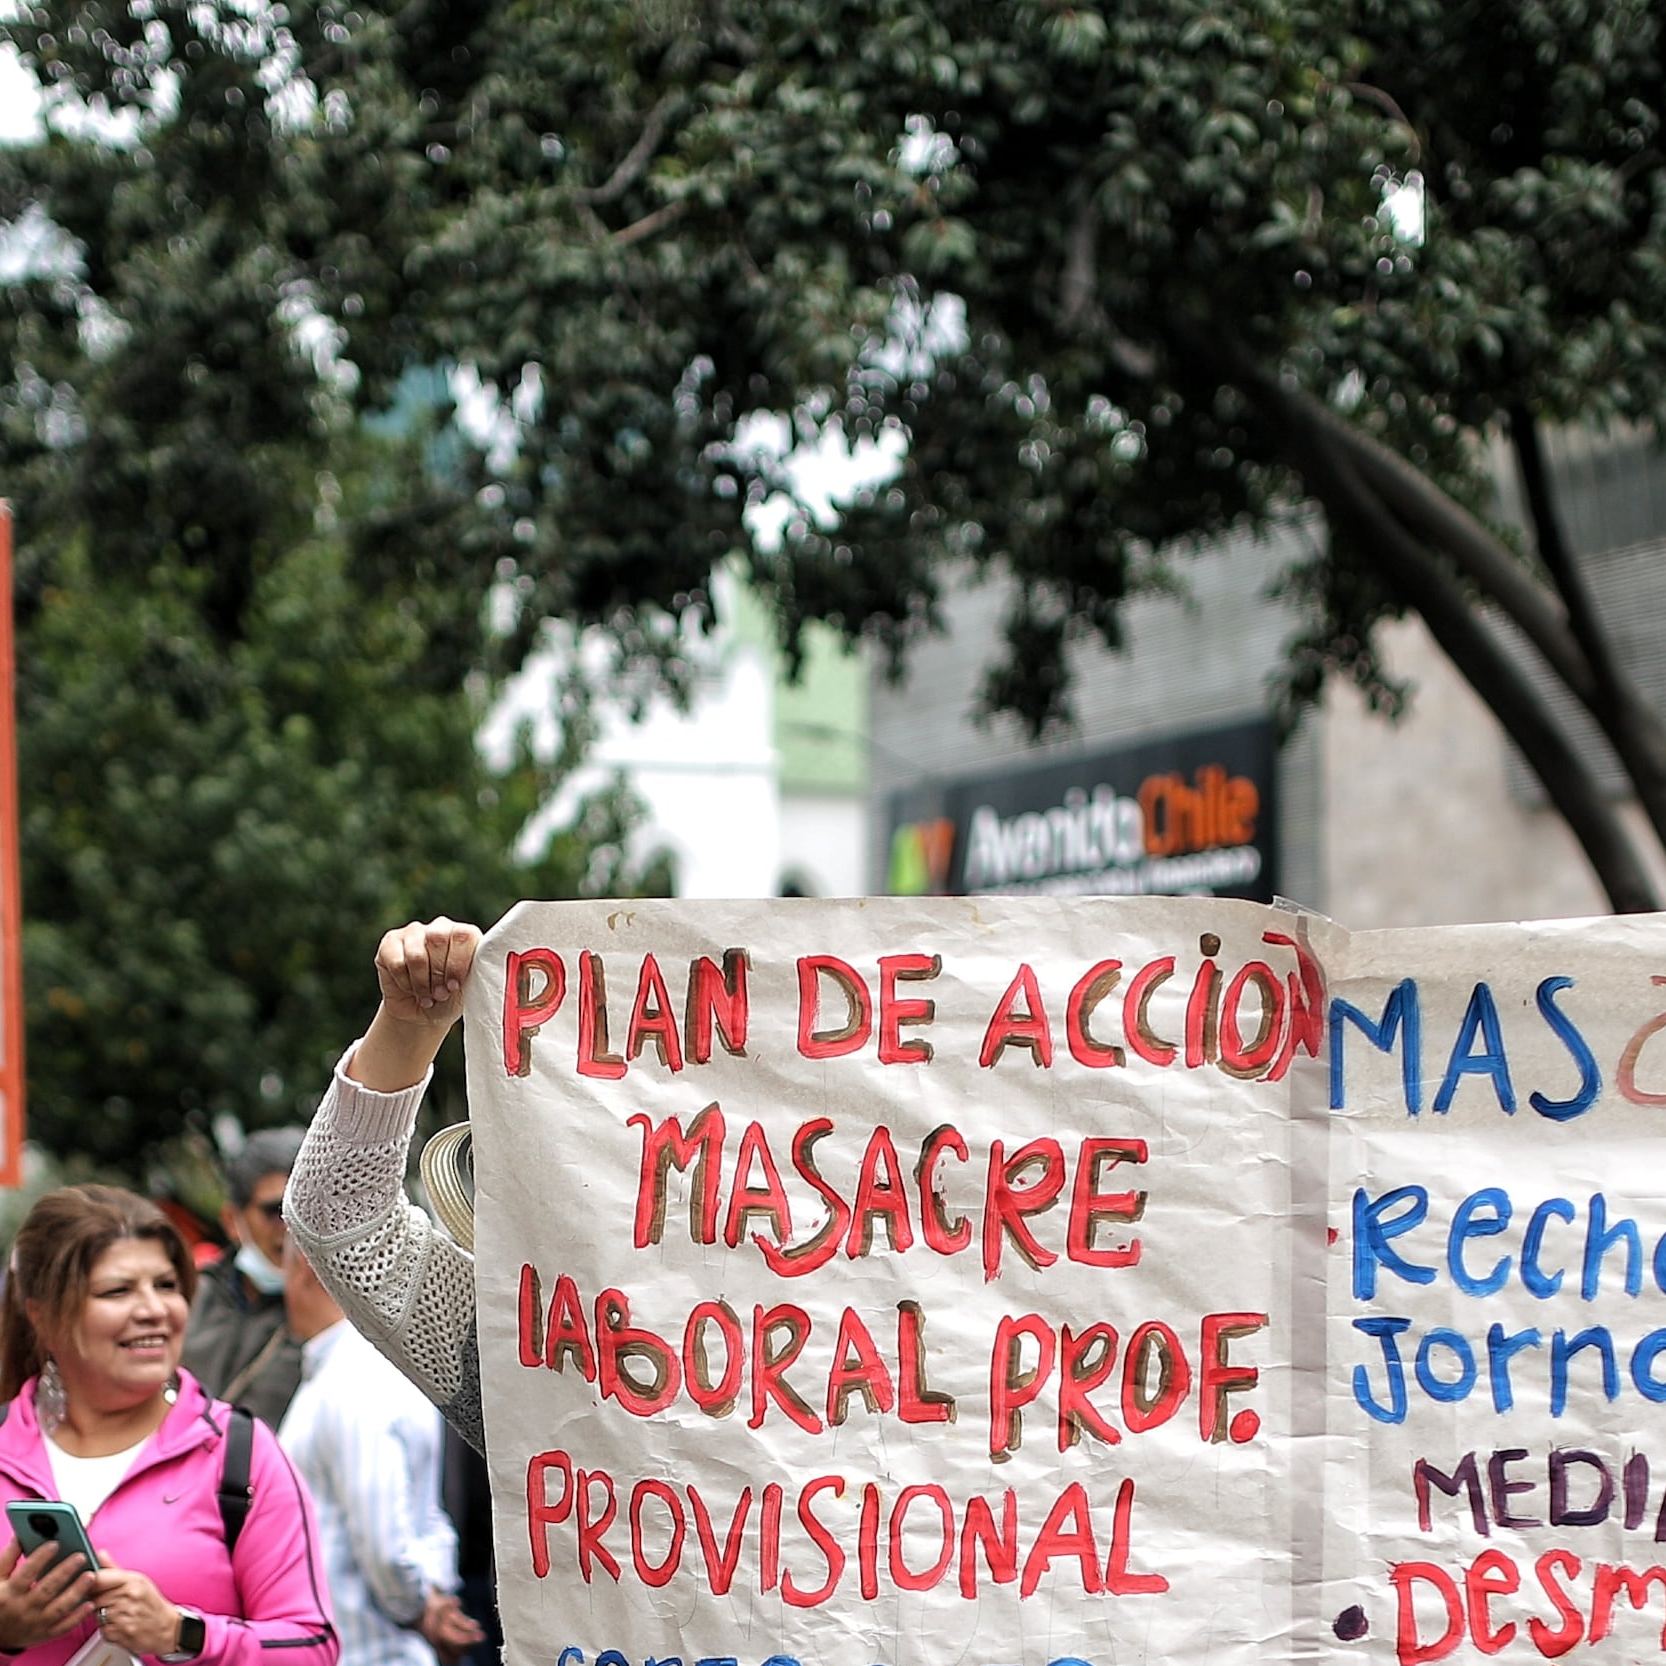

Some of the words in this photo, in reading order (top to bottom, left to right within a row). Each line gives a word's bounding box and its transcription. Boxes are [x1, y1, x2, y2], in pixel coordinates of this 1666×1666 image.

[503, 947, 751, 1078] PLAN
[797, 953, 941, 1065] DE
[1329, 975, 1604, 1122] MAS
[627, 1102, 1149, 1282] MASACRE
[526, 1450, 1171, 1605] PROVISIONAL
